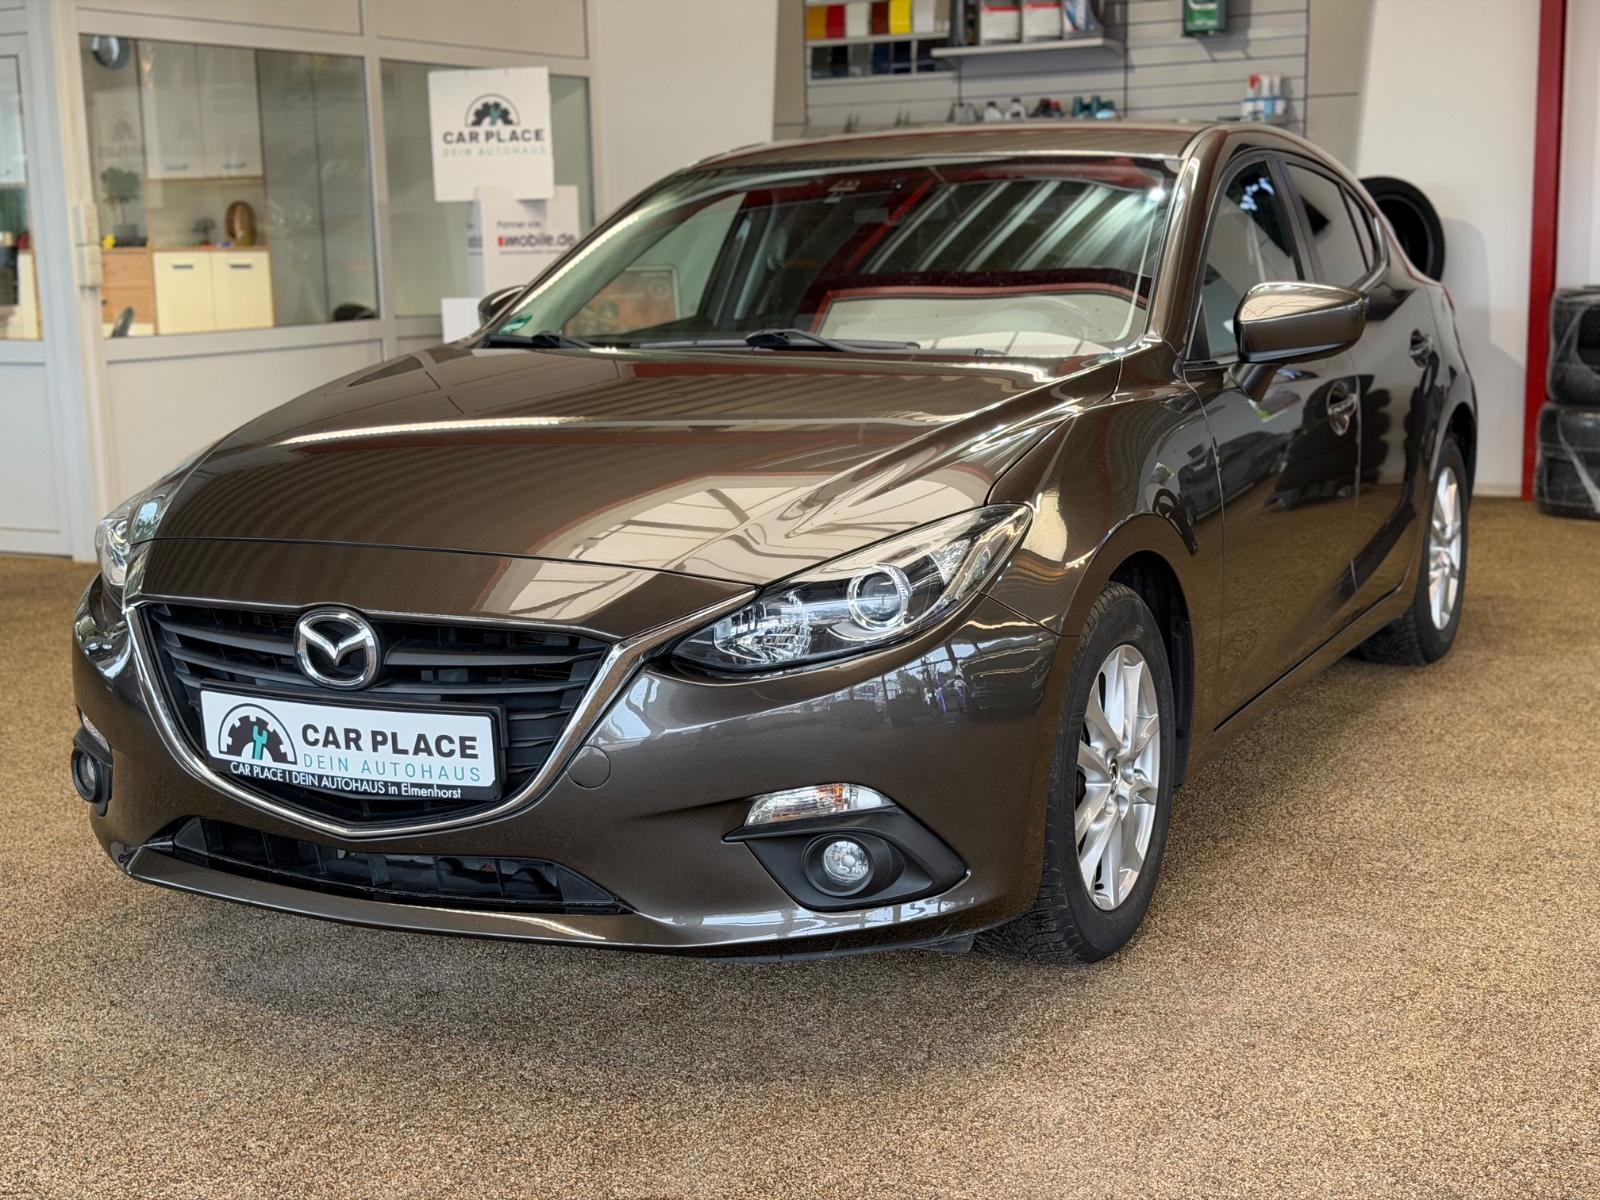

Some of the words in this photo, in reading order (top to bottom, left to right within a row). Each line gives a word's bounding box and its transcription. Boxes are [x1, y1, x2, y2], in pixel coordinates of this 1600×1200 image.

[443, 132, 480, 144] CAR
[485, 129, 545, 143] PLACE
[443, 147, 473, 157] DEIN
[478, 145, 545, 155] AUTOHAUS
[301, 723, 363, 752] CAR
[371, 730, 479, 759] PLACE
[230, 761, 251, 776] CAR
[253, 764, 284, 782] PLACE
[292, 771, 318, 787] DEIN
[321, 776, 386, 794] AUTOHAUS
[388, 784, 399, 795] in
[401, 783, 462, 799] Elmenhorst
[303, 753, 349, 772] DEIN
[361, 759, 481, 782] AUTOHAUS
